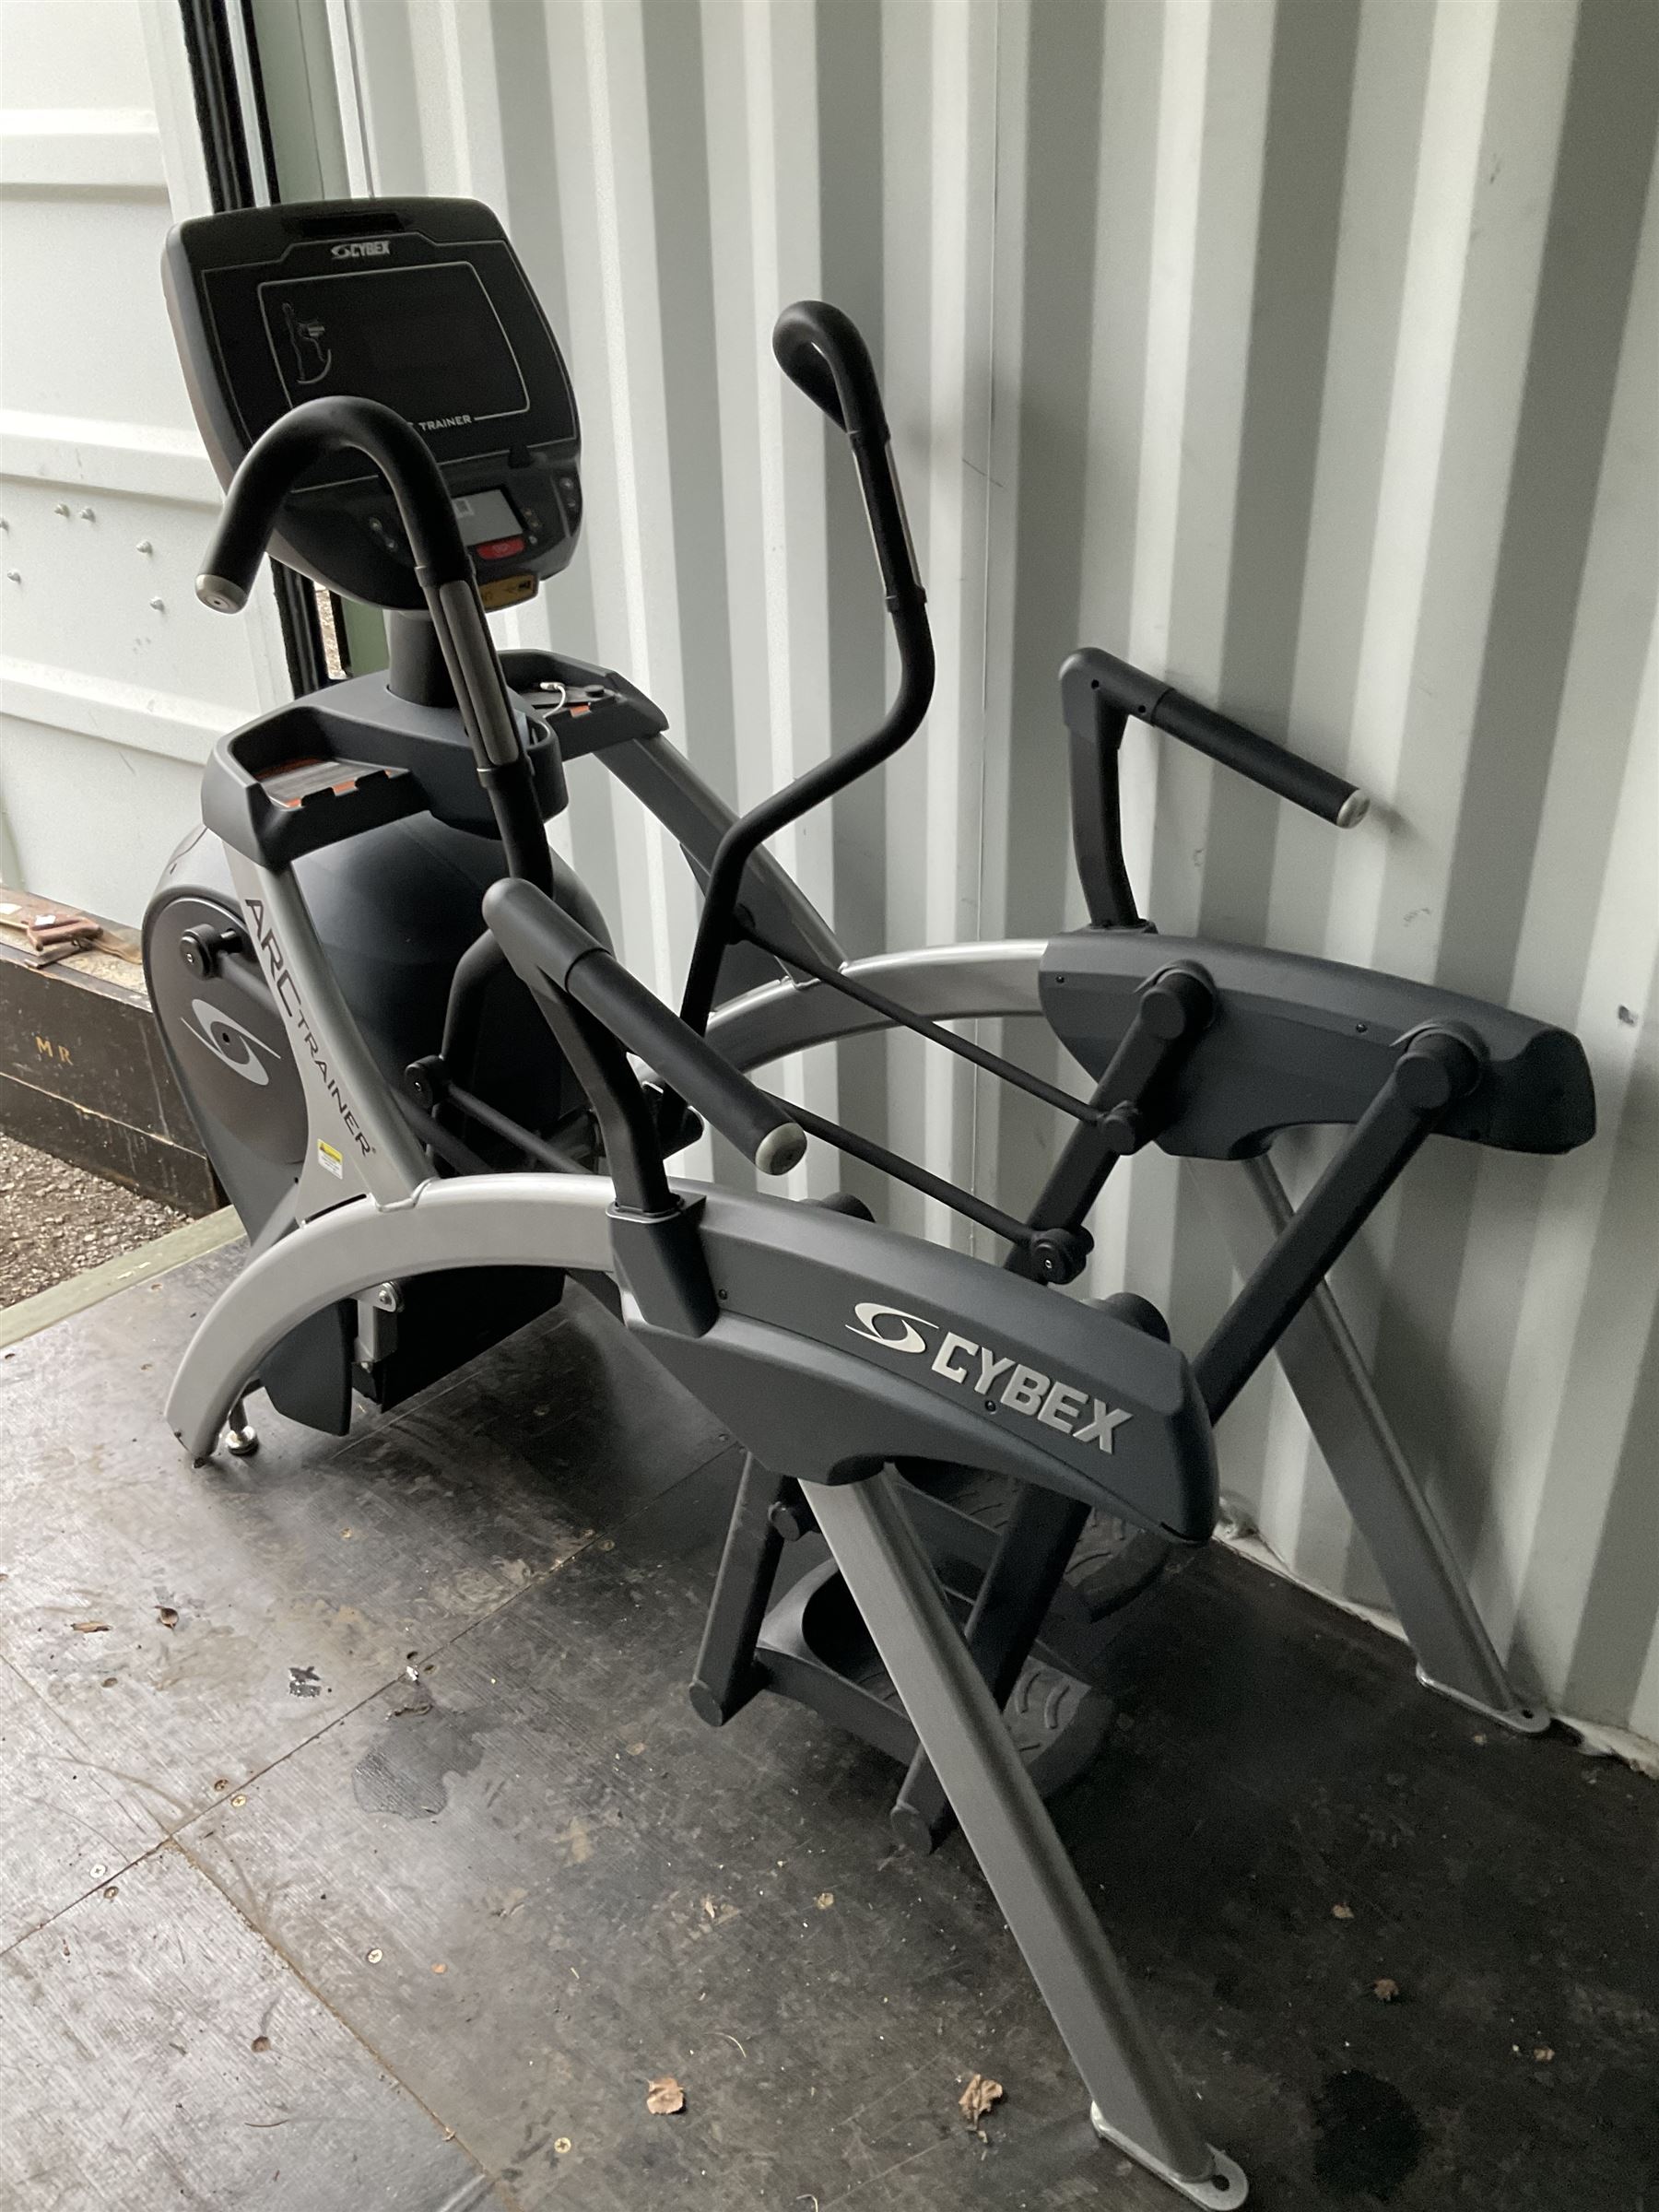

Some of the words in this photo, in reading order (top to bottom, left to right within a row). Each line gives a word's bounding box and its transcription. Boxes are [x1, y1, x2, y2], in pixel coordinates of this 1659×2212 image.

[350, 241, 390, 257] CYBEX
[418, 415, 472, 431] TRAINER
[246, 899, 301, 1017] ARC
[297, 1008, 371, 1157] TRAINER
[931, 1331, 1134, 1454] CYBEX
